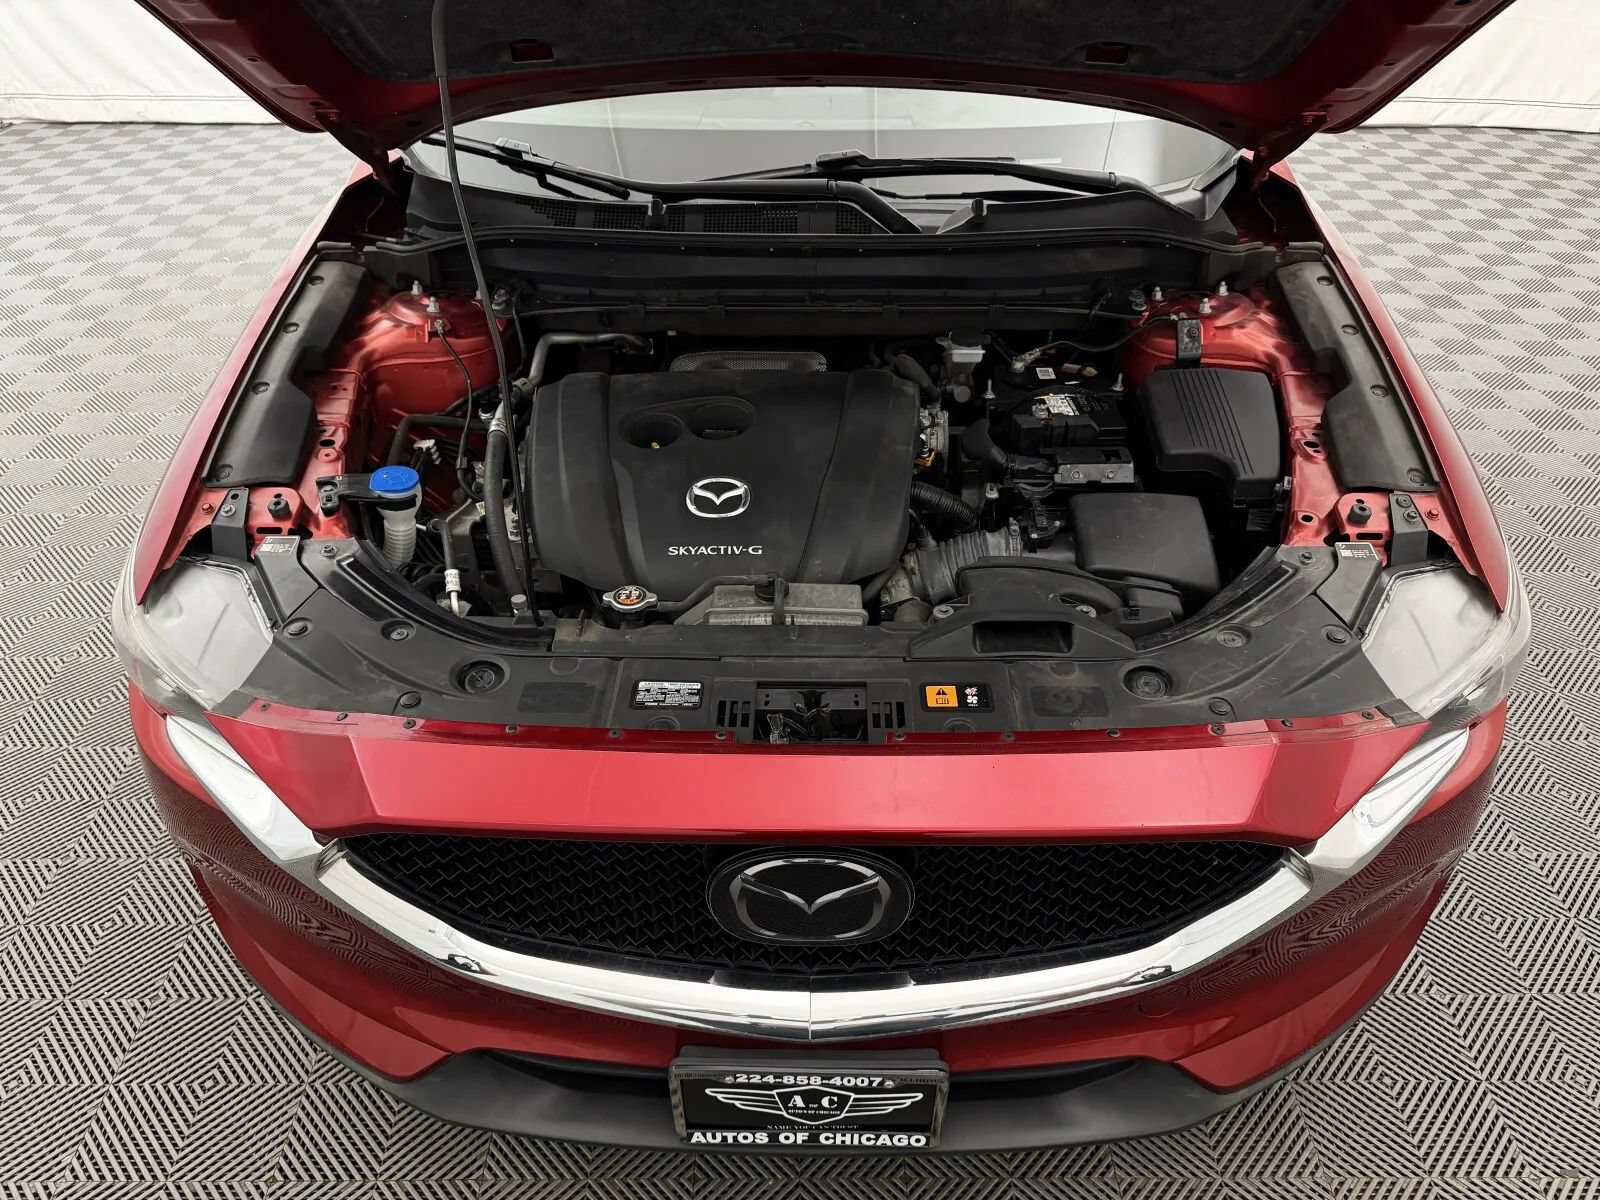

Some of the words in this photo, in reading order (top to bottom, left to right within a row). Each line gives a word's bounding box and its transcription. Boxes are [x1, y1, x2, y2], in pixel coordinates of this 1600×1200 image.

[667, 545, 763, 556] SKYACTIV-G
[735, 1073, 883, 1087] 224-858-4007
[690, 1131, 769, 1144] AUTOS
[778, 1132, 810, 1144] OF
[819, 1132, 927, 1147] CHICAGO
